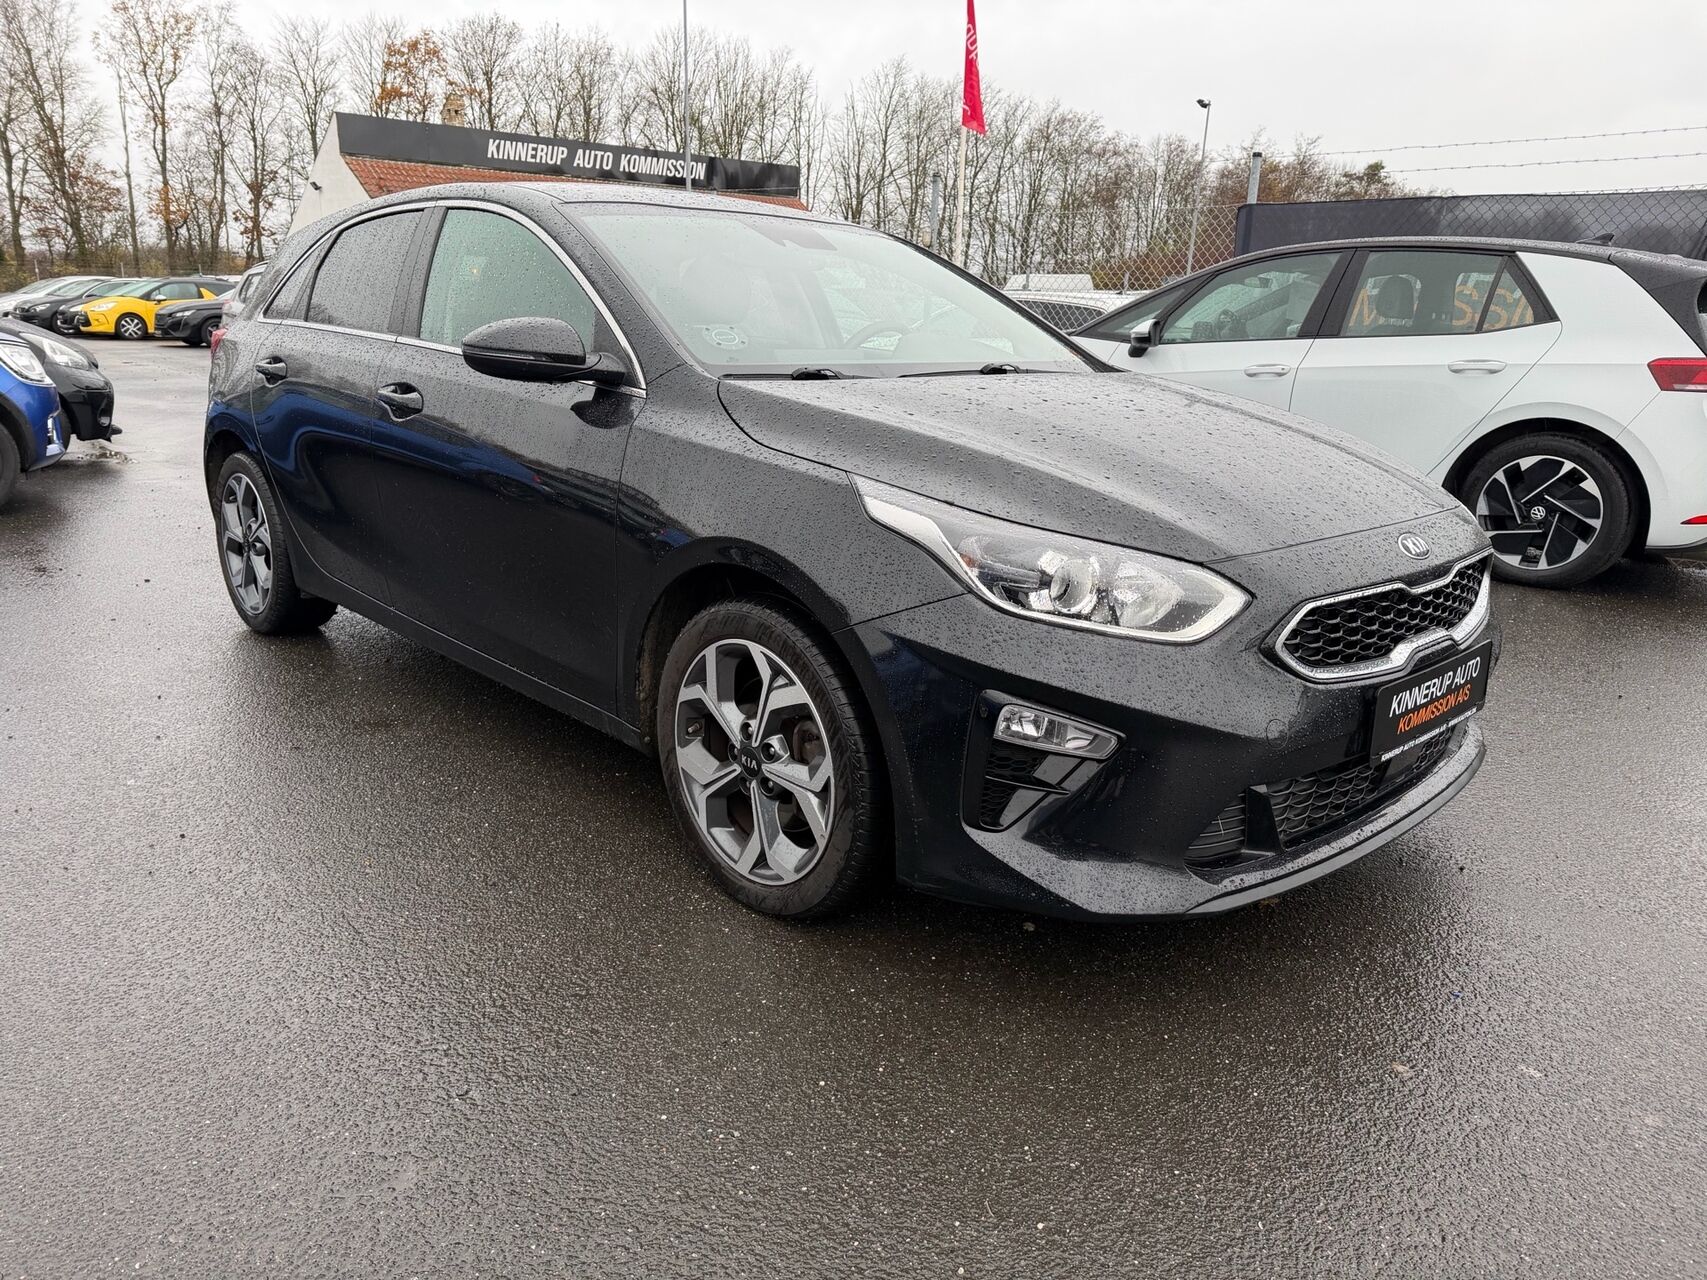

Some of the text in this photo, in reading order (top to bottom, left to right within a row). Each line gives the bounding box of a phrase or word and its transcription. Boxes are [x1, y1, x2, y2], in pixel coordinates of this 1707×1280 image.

[487, 139, 706, 180] KINNERUP AUTO KOMMISSION
[1389, 671, 1454, 718] KINNERUP
[1452, 656, 1481, 689] AUTO
[1397, 692, 1458, 735] KOMMISSION
[741, 754, 758, 770] KIA
